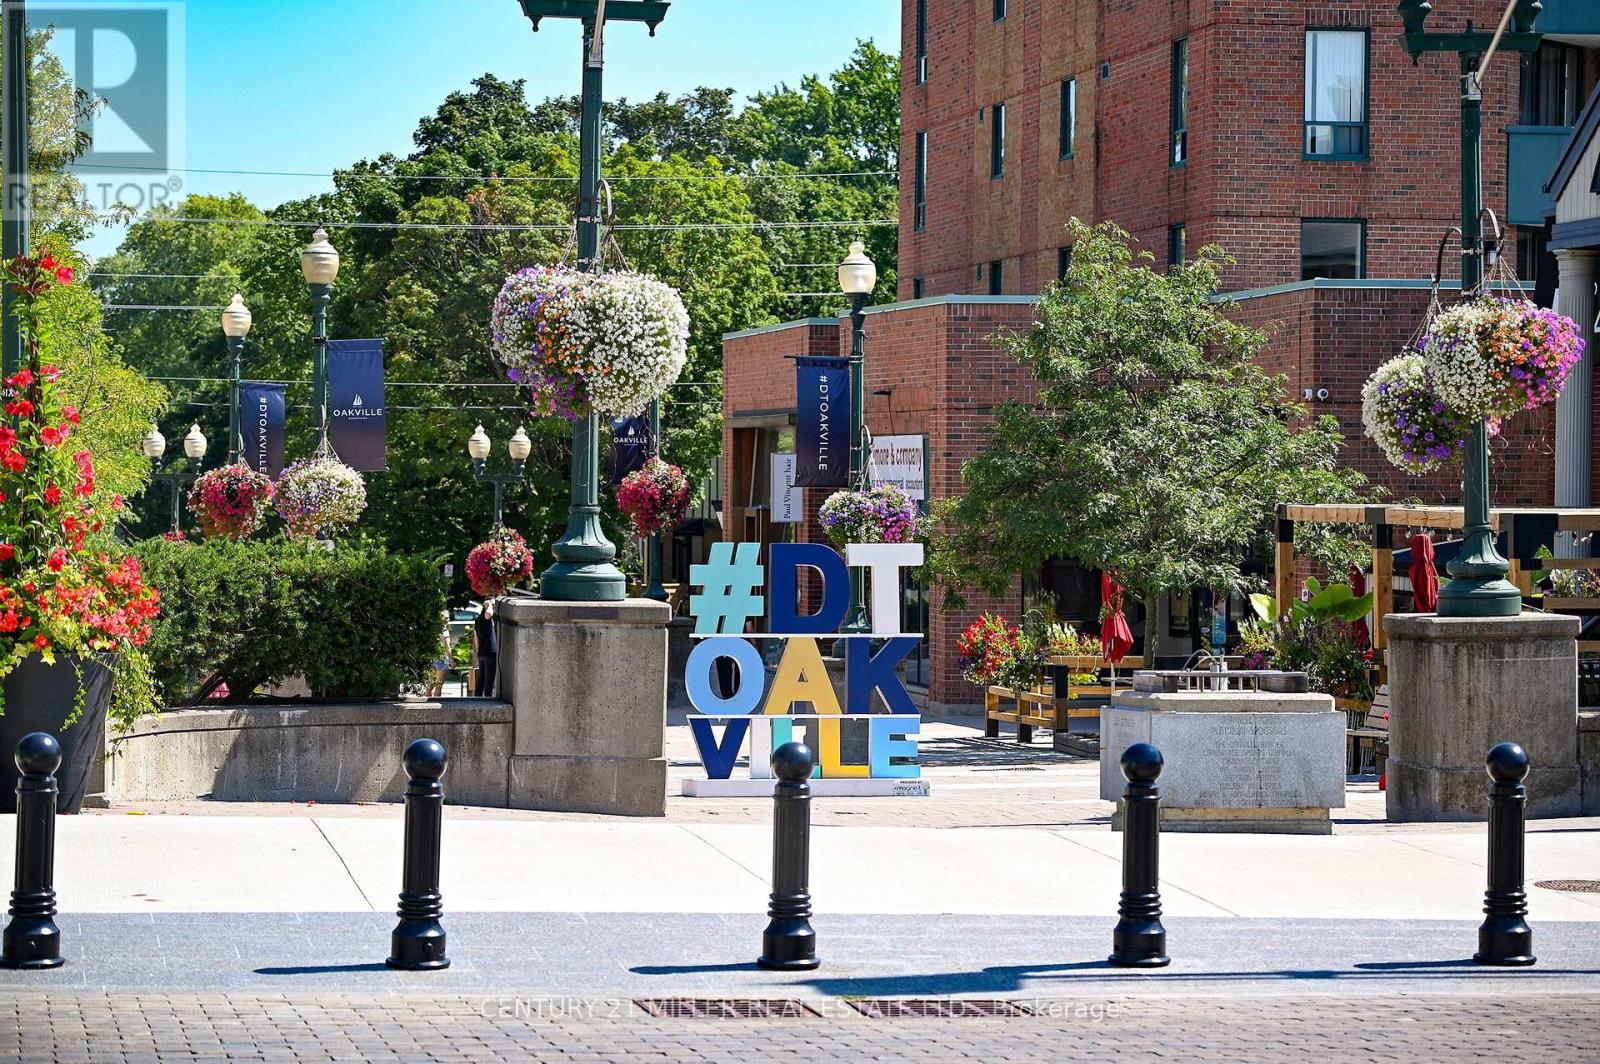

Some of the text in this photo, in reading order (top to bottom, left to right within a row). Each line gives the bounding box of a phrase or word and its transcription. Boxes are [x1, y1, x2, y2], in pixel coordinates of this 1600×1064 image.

[259, 397, 267, 473] #DTOAKVILLE
[333, 408, 382, 417] OAKVILLE
[818, 375, 829, 471] #DTOAKVILLE
[783, 457, 791, 519] Paul Vincent hair
[896, 447, 922, 471] company
[688, 542, 924, 634] #DT
[684, 637, 923, 715] OAK
